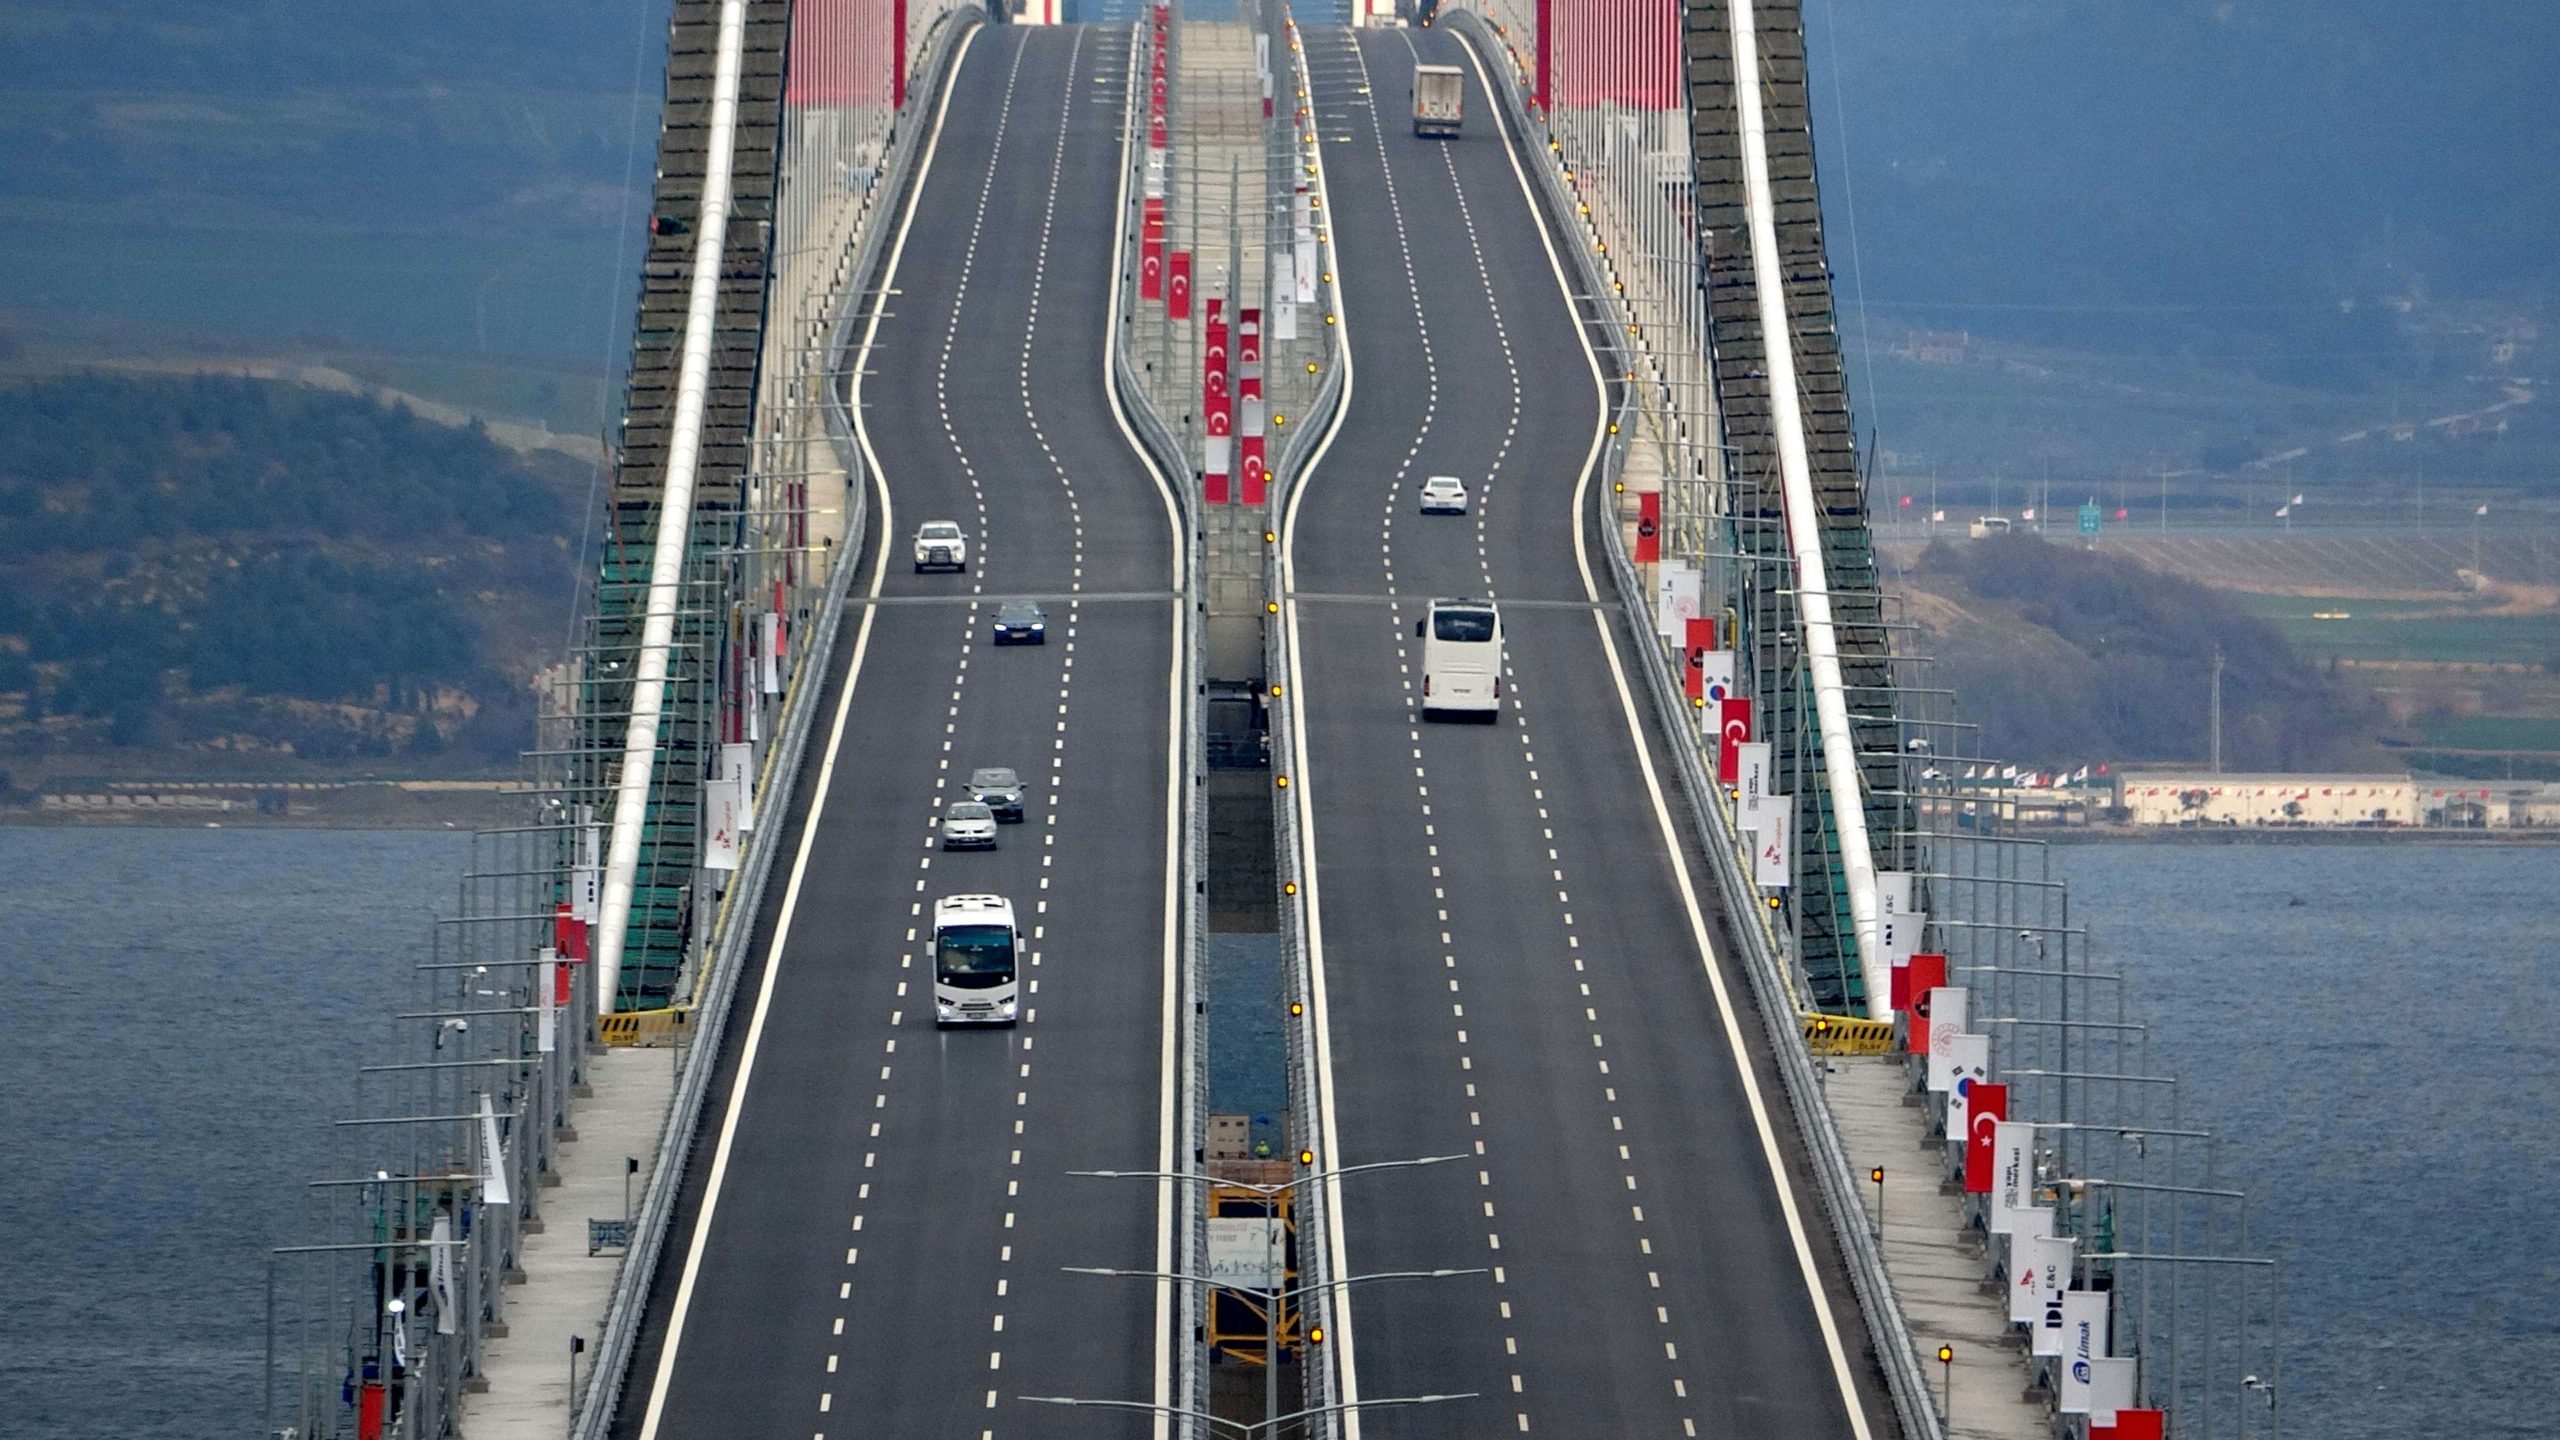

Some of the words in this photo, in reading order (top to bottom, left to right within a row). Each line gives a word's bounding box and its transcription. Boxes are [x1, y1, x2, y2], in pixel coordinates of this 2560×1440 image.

[2012, 1147, 2020, 1188] merkezi
[2046, 1264, 2056, 1289] E&C
[2077, 1320, 2090, 1360] Limak
